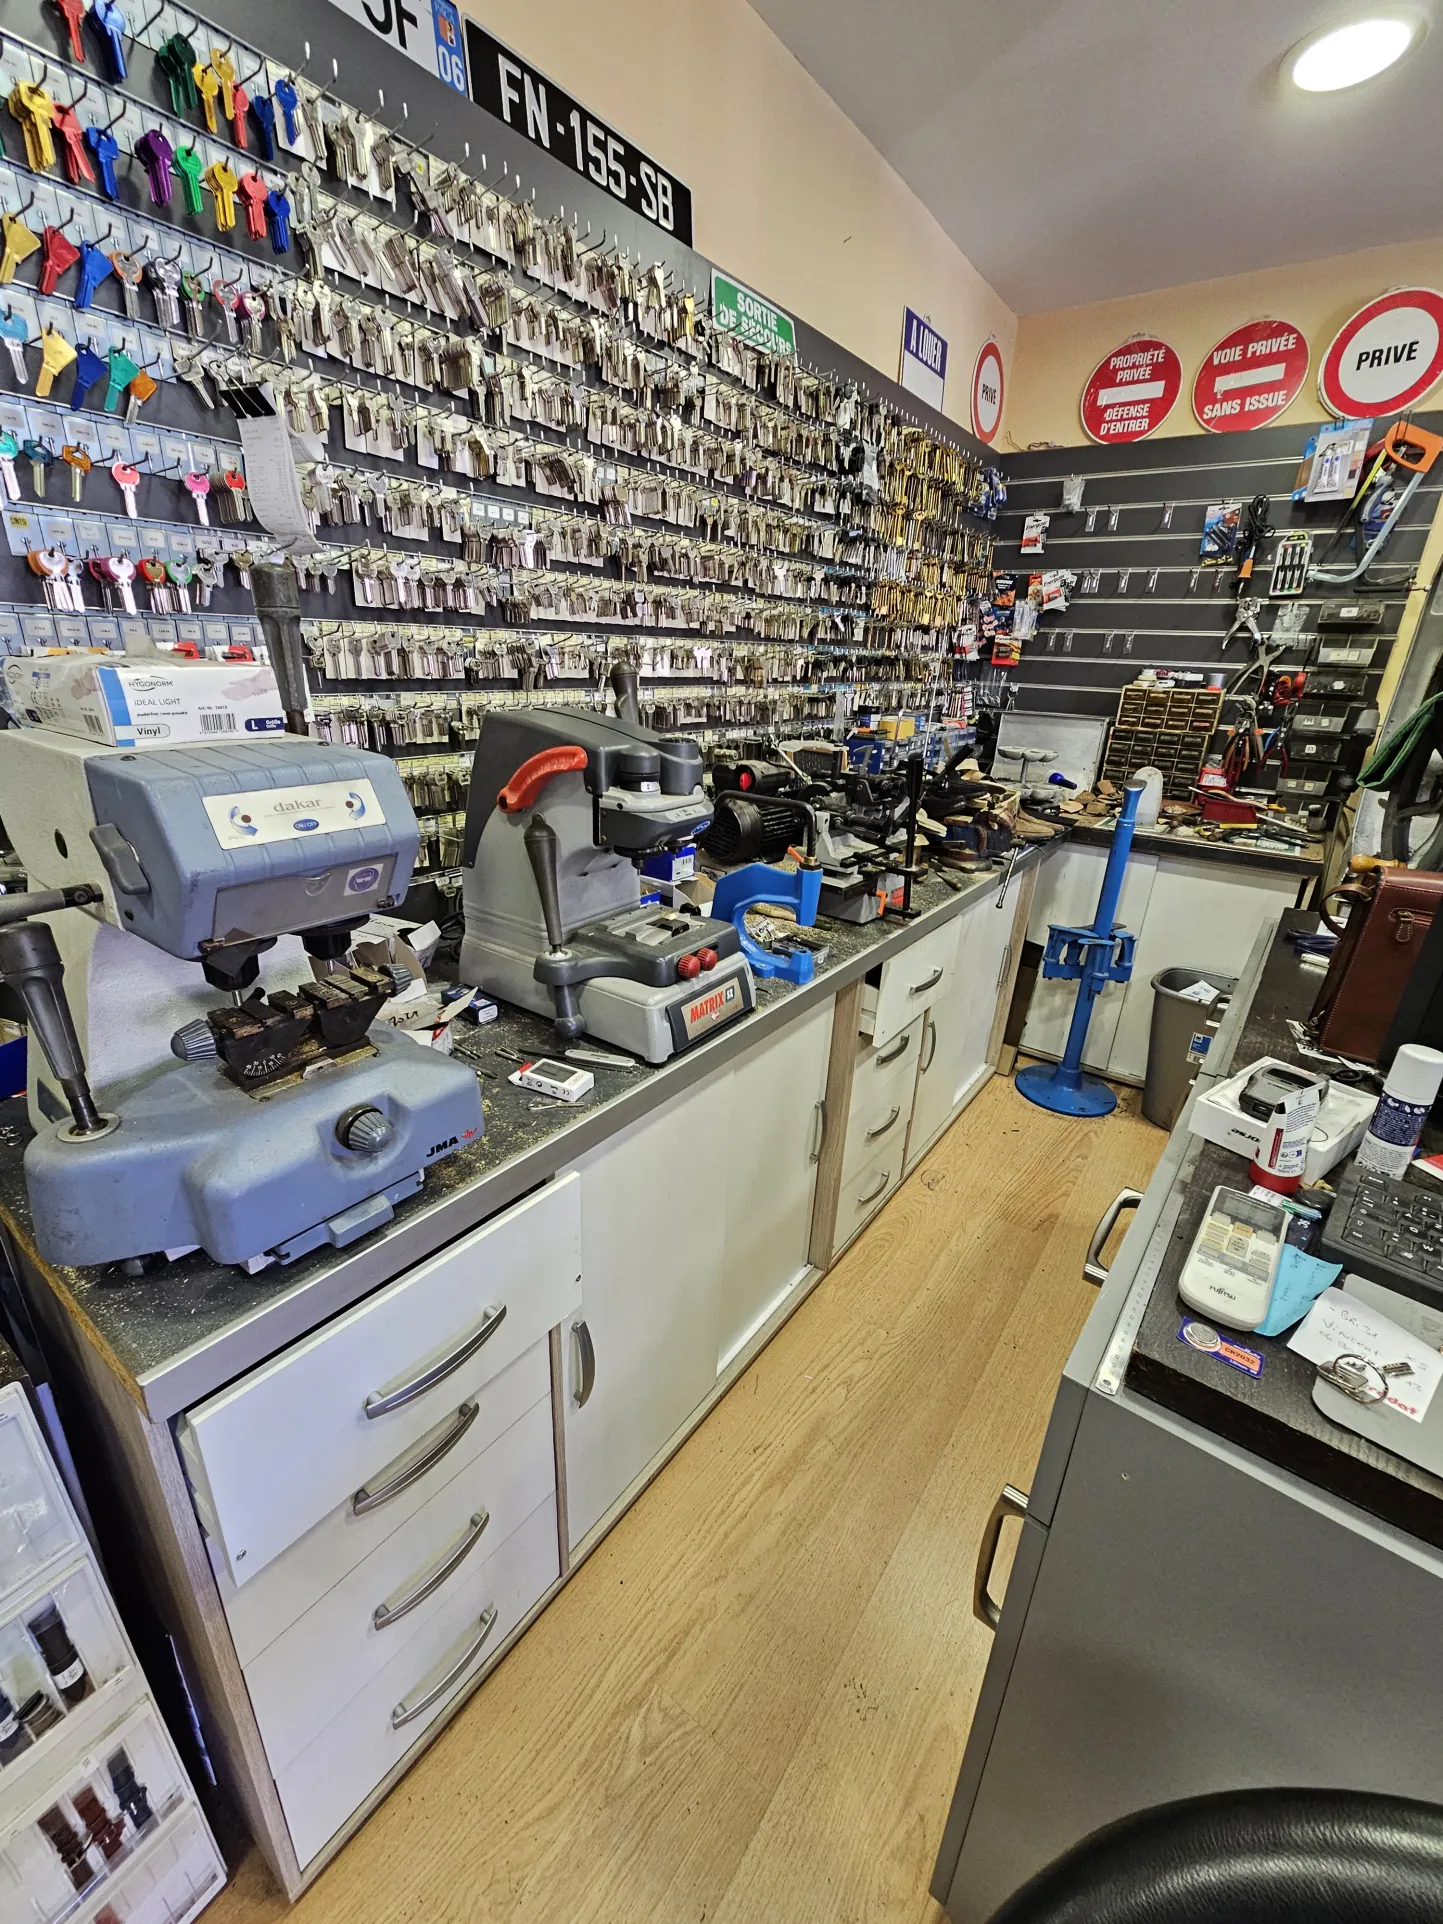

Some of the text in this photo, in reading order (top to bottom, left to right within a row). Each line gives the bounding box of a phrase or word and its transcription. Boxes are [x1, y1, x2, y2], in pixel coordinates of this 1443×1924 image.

[437, 44, 465, 92] 06
[498, 53, 674, 231] FN-155-SB
[737, 292, 778, 332] SORTIE
[720, 302, 792, 355] DE SECOURS
[910, 318, 943, 373] A LOUER
[1213, 334, 1298, 366] VOIE PRIVÉE
[1110, 348, 1166, 370] PROPRIÉTÉ
[1116, 365, 1152, 383] PRIVÉE
[1106, 403, 1150, 420] DÉFENSE
[1203, 390, 1288, 420] SANS ISSUE
[1100, 418, 1150, 436] D'ENTRER
[1026, 520, 1048, 531] Energizer
[1044, 574, 1066, 587] Energizer
[128, 680, 173, 688] HYGONORM
[134, 698, 181, 707] IDEAL LIGHT
[137, 726, 162, 737] Vinyl
[251, 719, 259, 730] L
[273, 797, 323, 813] dakar
[689, 990, 725, 1025] MATRIX
[426, 1136, 459, 1158] JMA
[1209, 1285, 1237, 1301] FUJITSU
[1224, 1346, 1256, 1365] CR2032
